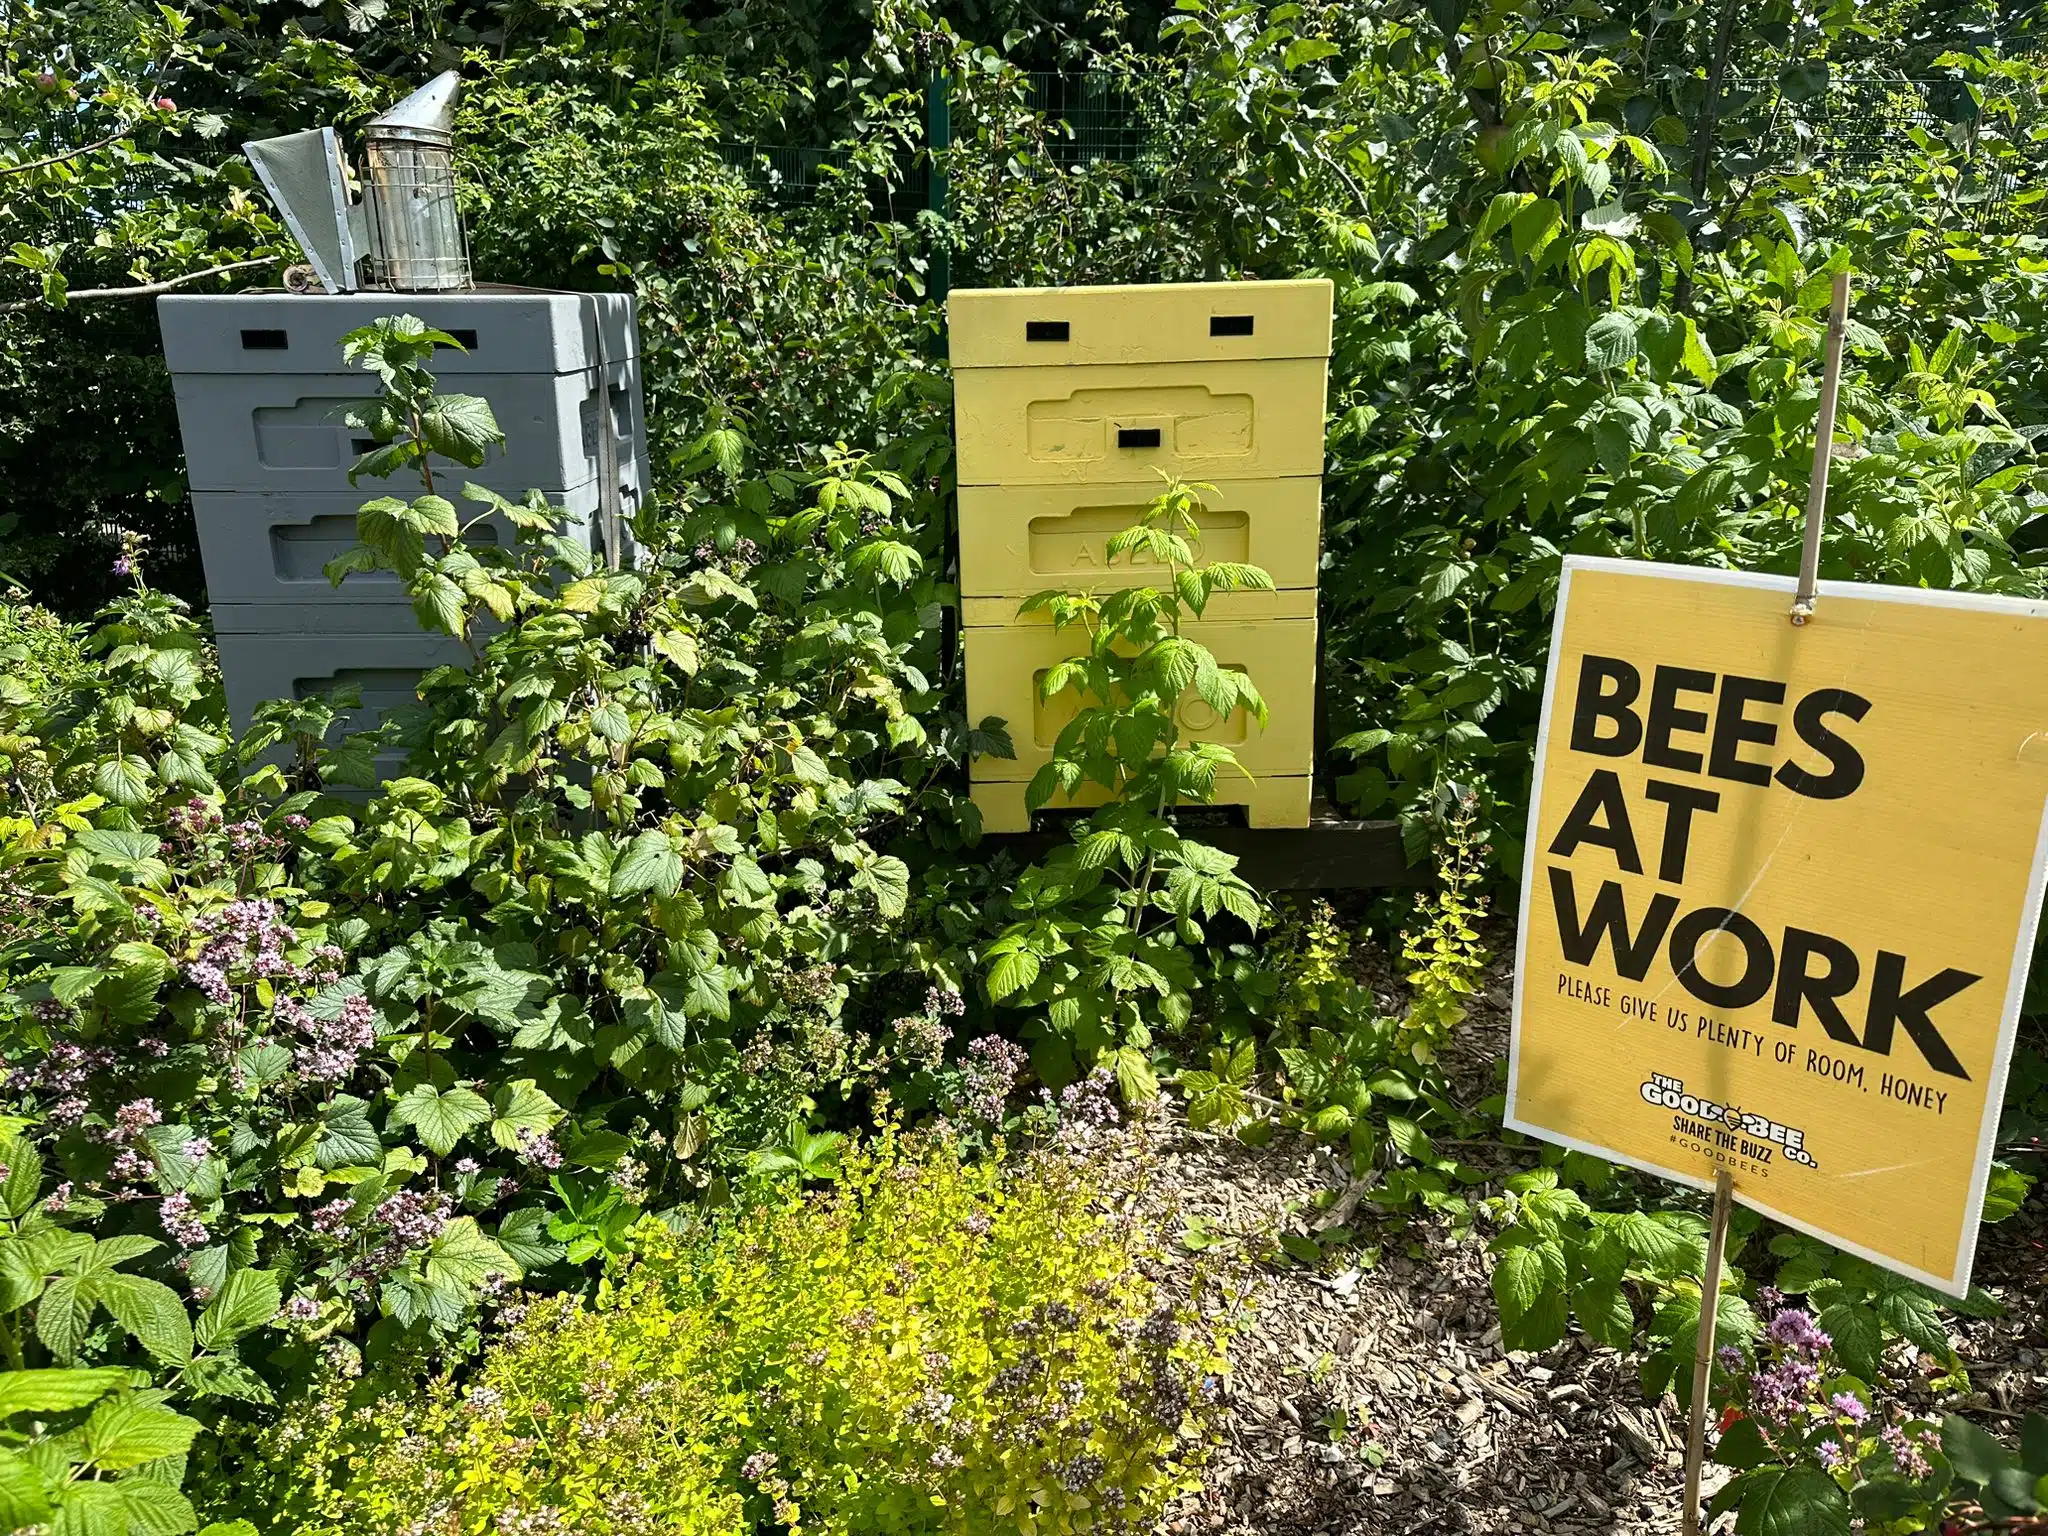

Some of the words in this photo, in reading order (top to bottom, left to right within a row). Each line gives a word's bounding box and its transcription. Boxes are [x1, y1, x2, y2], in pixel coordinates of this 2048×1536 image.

[1569, 654, 1872, 800] BEES
[1547, 768, 1720, 885] AT
[1547, 865, 1984, 1082] WORK
[1558, 973, 1611, 1007] PLEASE
[1620, 995, 1657, 1022] GIVE
[1667, 1007, 1688, 1032] US
[1697, 1016, 1764, 1057] PLENTY
[1775, 1041, 1796, 1064] OF
[1880, 1073, 1948, 1115] HONEY
[1640, 1081, 1724, 1122] GOOD
[1741, 1112, 1804, 1150] BEE
[1651, 1072, 1683, 1095] THE
[1669, 1135, 1769, 1178] #GOODBEES
[1673, 1115, 1711, 1142] SHARE
[1715, 1129, 1738, 1152] THE
[1740, 1140, 1773, 1164] BUZZ
[1782, 1145, 1818, 1169] CO.
